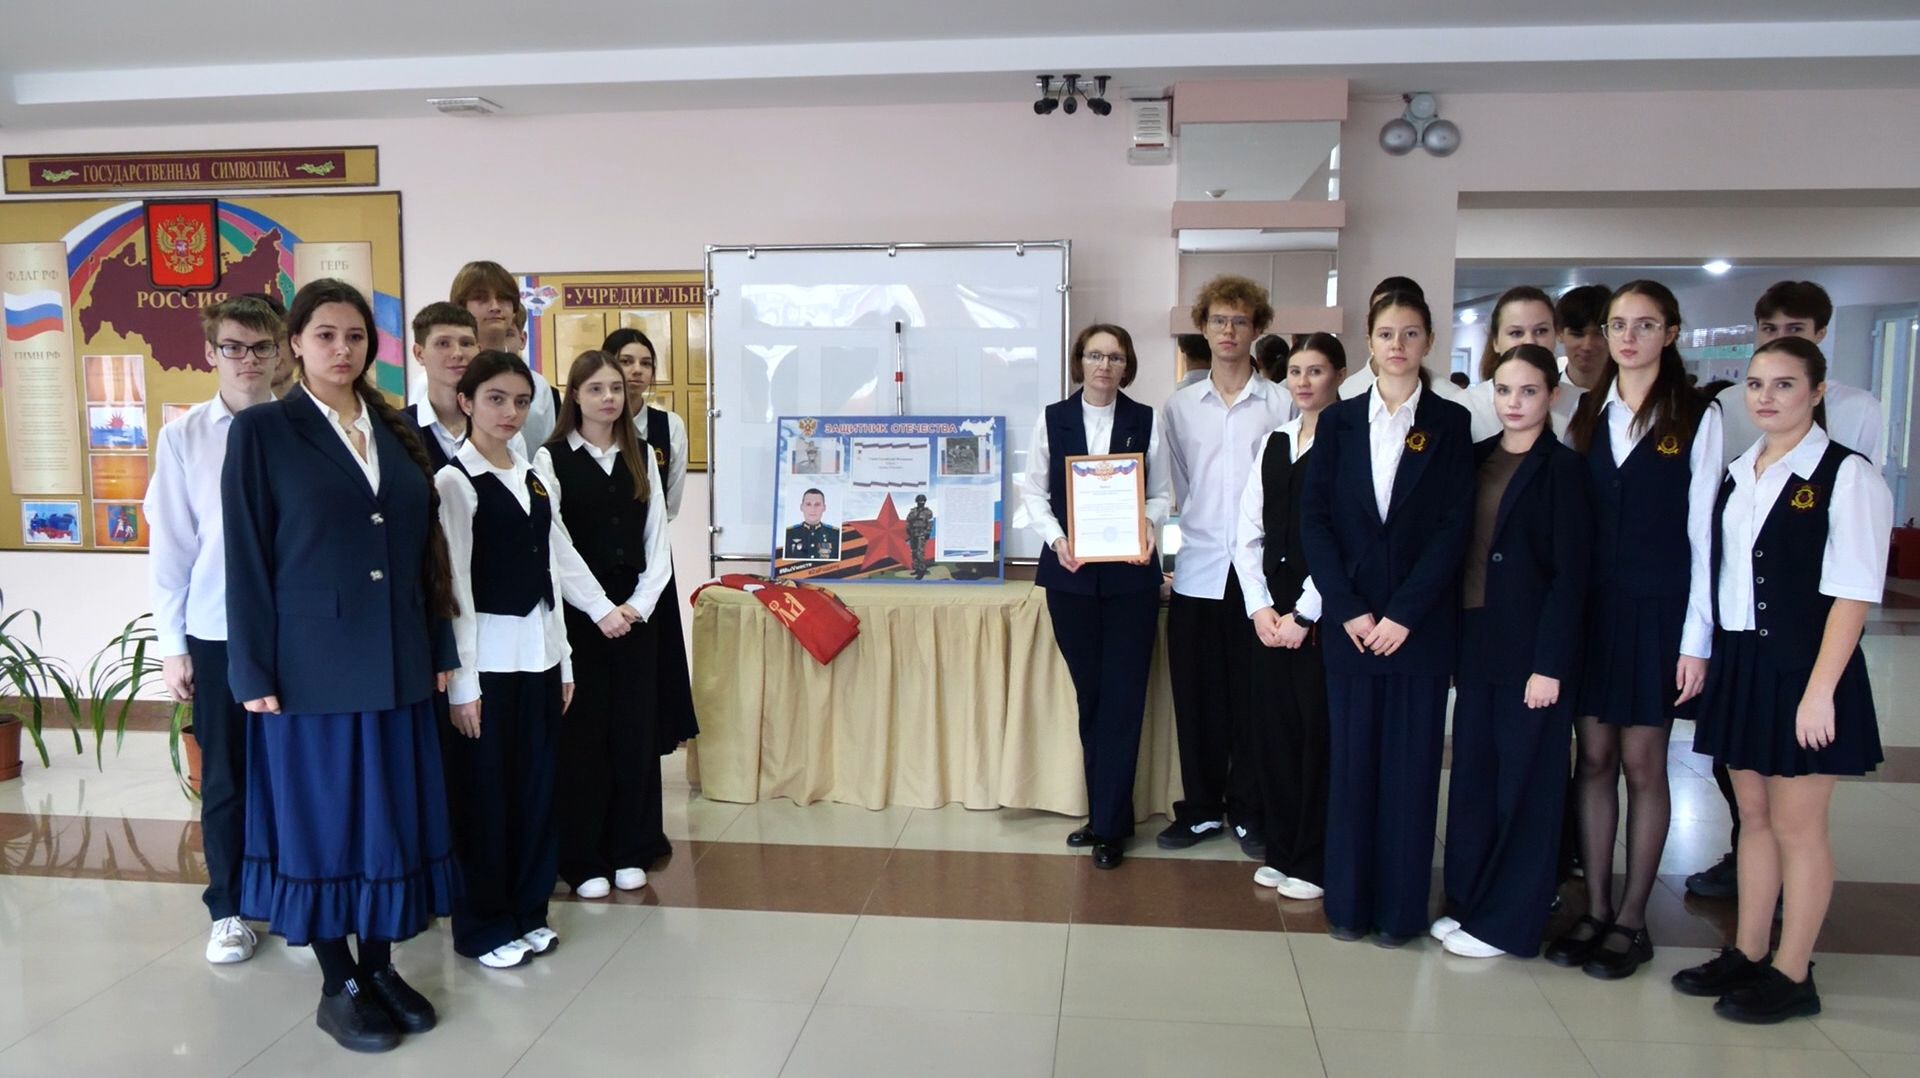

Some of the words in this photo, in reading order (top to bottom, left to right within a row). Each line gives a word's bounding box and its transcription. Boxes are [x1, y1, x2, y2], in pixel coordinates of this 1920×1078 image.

[83, 162, 201, 184] ГОСУДАРСТВЕННАЯ
[211, 160, 291, 181] СИМВОЛИКА
[320, 260, 350, 271] ГЕРБ
[6, 269, 40, 281] ФЛАГ
[42, 269, 60, 281] РФ
[136, 291, 229, 310] РОССИЯ
[574, 287, 705, 306] УЧРЕДИТЕЛЬН
[824, 423, 888, 435] ЗАЩИТНИК
[891, 422, 958, 434] ОТЕЧЕСТВА
